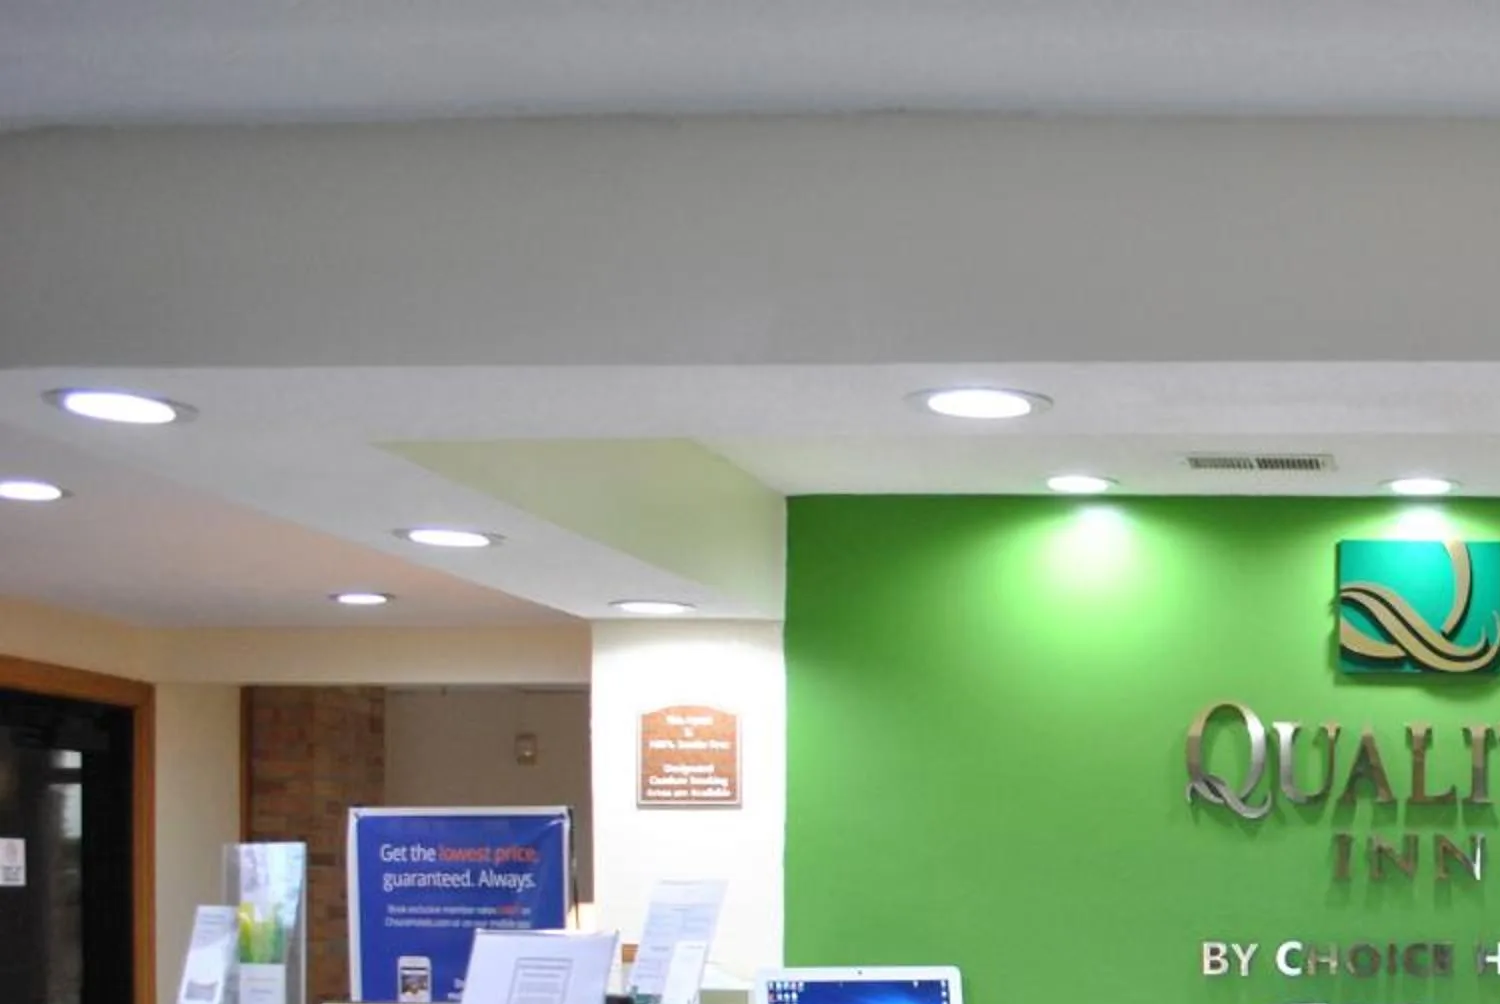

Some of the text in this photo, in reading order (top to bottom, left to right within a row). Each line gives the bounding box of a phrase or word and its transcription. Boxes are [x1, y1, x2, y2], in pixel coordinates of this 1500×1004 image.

[380, 843, 407, 862] Get
[410, 843, 436, 862] the
[439, 844, 490, 862] lowest
[1333, 832, 1486, 880] INN
[383, 869, 536, 892] guaranteed. Always.
[1202, 941, 1258, 977] BY
[1275, 940, 1454, 978] CHOICE
